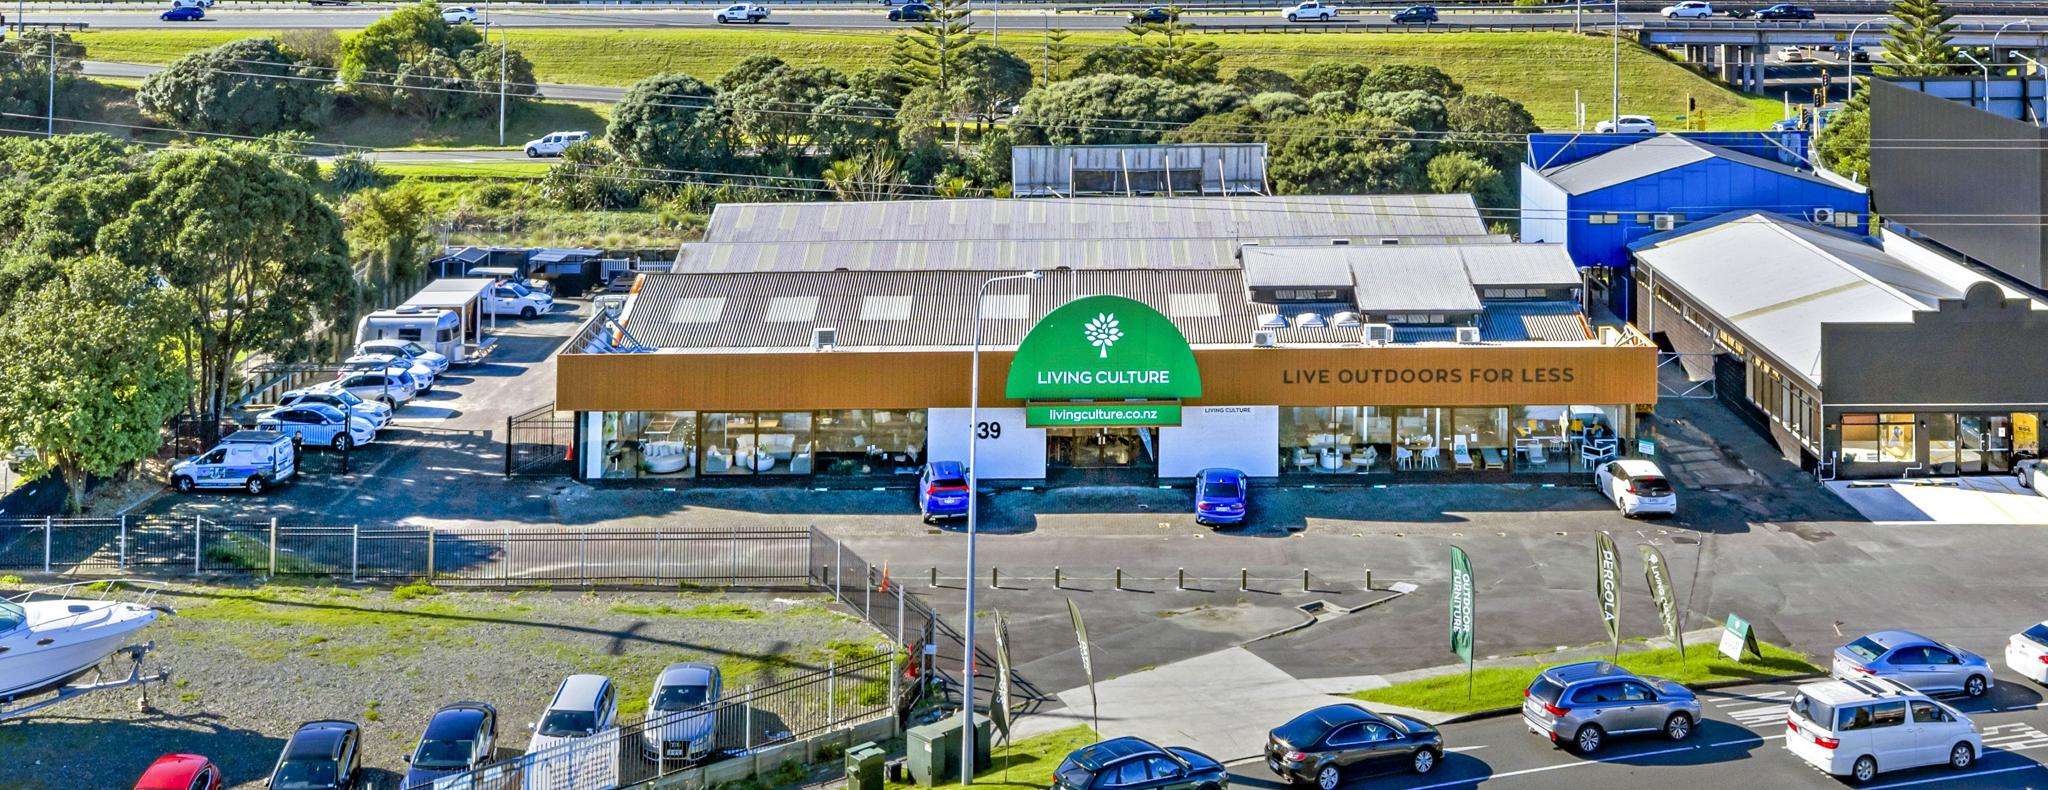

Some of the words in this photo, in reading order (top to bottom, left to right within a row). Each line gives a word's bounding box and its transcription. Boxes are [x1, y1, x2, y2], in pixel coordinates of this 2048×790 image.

[1037, 371, 1092, 384] LIVING
[1095, 370, 1170, 384] CULTURE
[1282, 368, 1330, 384] LIVE
[1338, 367, 1462, 383] OUTDOORS
[1470, 367, 1513, 382] FOR
[1521, 366, 1575, 382] LESS
[1049, 409, 1158, 422] livingculture.co.nz
[969, 421, 1001, 440] 39
[1602, 550, 1615, 622] PERGOLA
[1651, 565, 1665, 598] LIVING
[1453, 569, 1463, 633] FURNITURE
[1462, 573, 1471, 632] OUTDOOR
